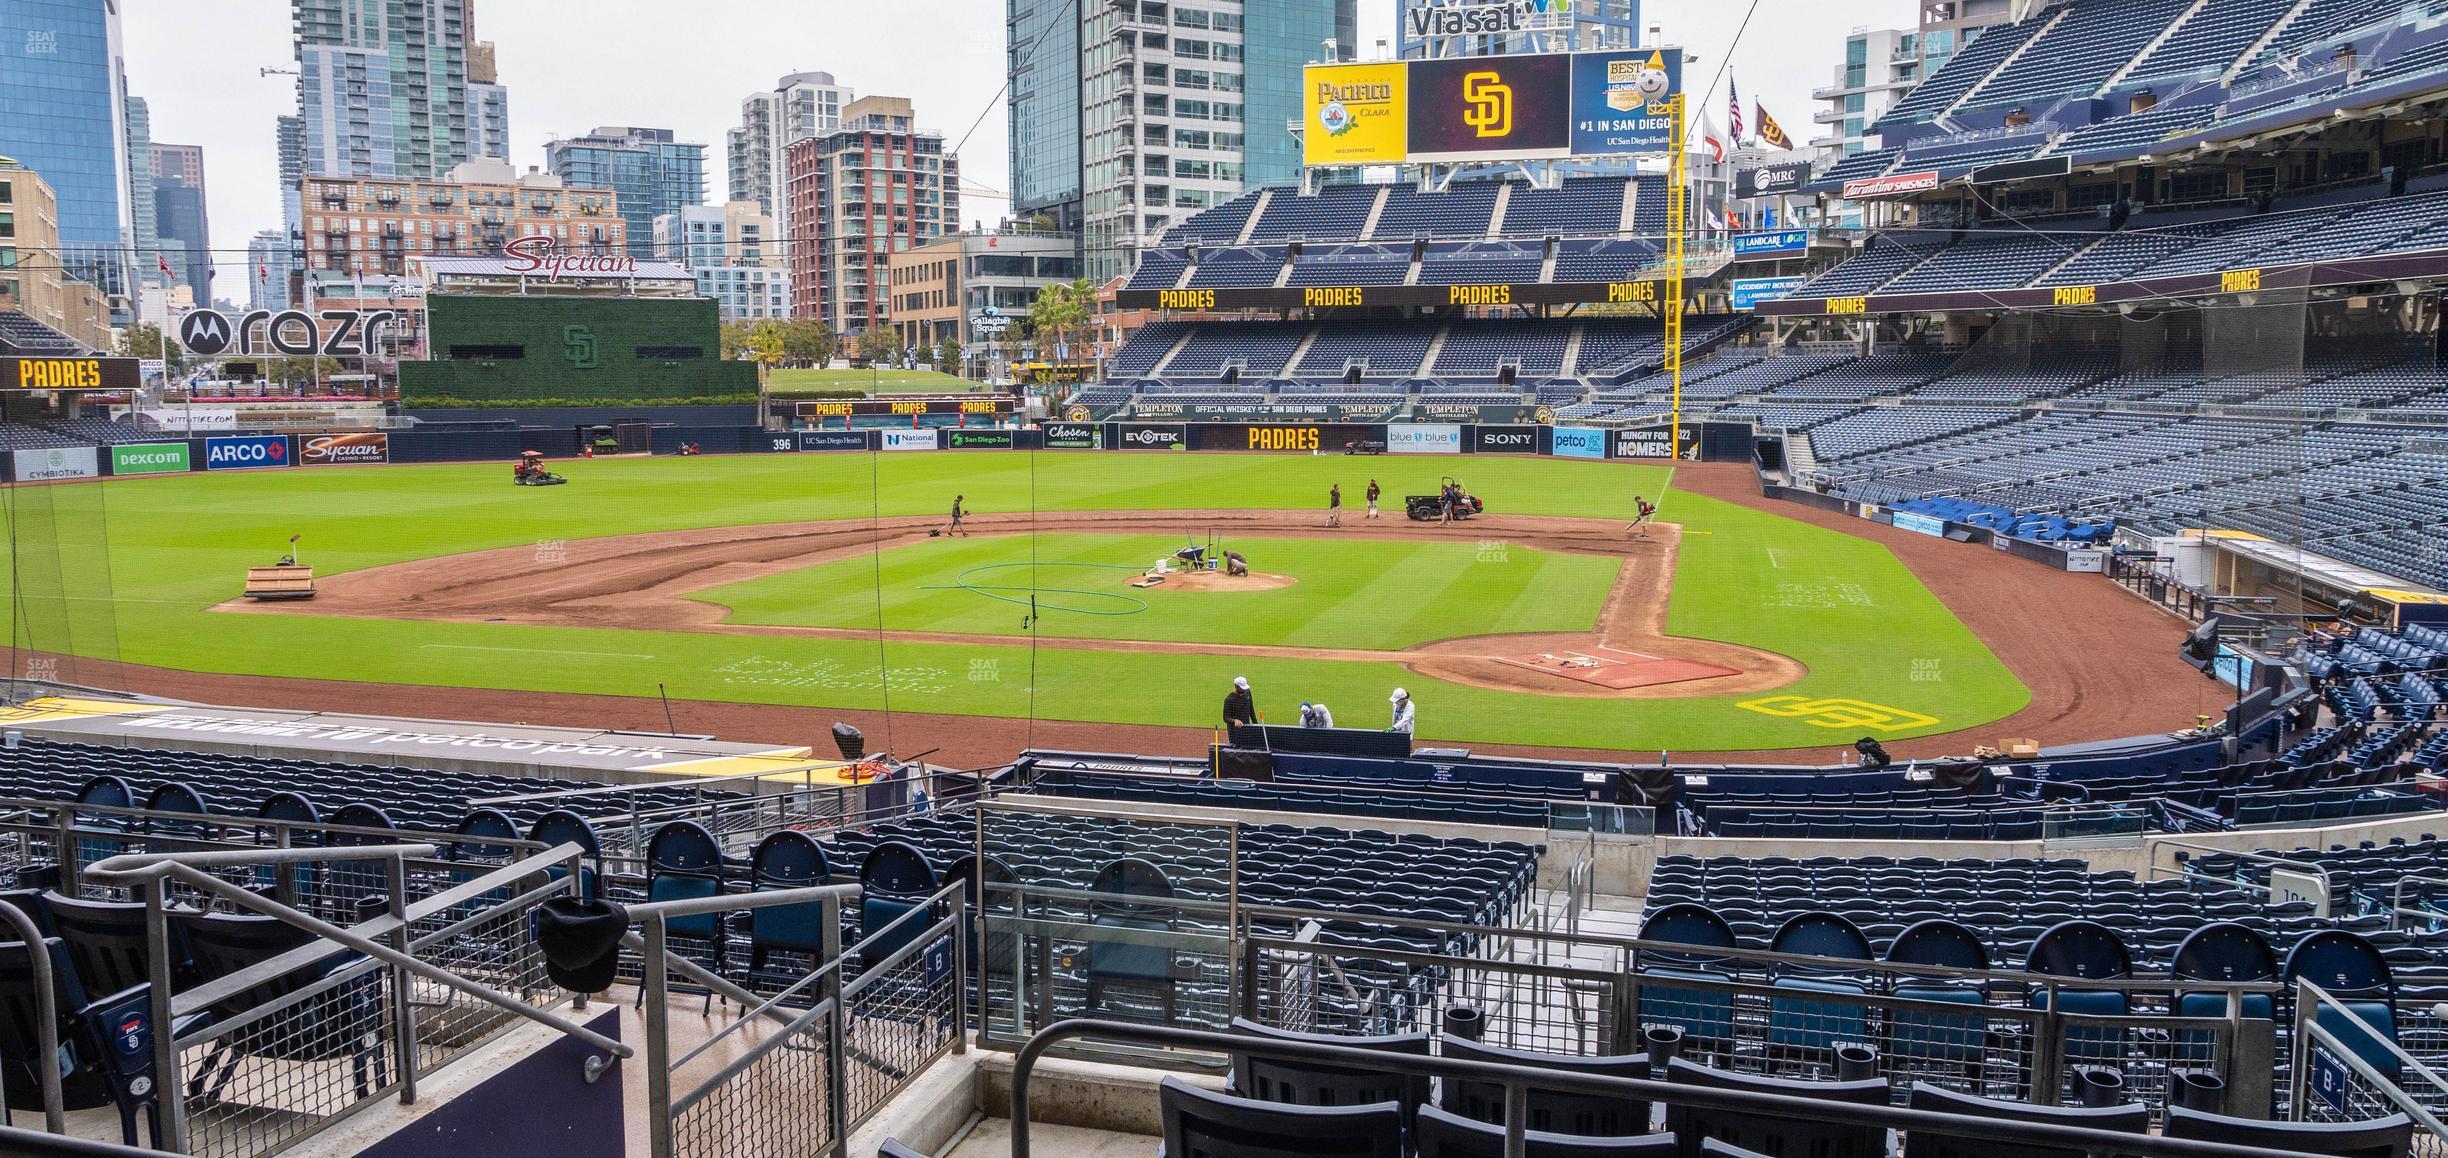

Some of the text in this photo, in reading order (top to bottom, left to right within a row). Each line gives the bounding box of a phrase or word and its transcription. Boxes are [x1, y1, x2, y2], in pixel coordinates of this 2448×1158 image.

[1411, 3, 1521, 36] Viasat
[1610, 62, 1642, 74] BEST
[1580, 118, 1670, 131] #1 IN SAN DIEGO
[1618, 137, 1630, 145] San
[1631, 136, 1649, 145] Diego
[1650, 135, 1670, 144] Health
[1770, 169, 1795, 182] MRC
[1846, 178, 1935, 196] Tarantino SAUSAGES
[1746, 233, 1806, 246] LANDCARE LOGIC
[504, 236, 638, 283] Sycuan
[2222, 269, 2260, 291] PADRES
[1305, 287, 1363, 307] PADRES
[1450, 284, 1510, 305] PADRES
[1609, 281, 1655, 302] PADRES
[2054, 286, 2096, 305] PADRES
[1160, 289, 1215, 308] PADRES
[1826, 297, 1866, 313] PADRES
[970, 317, 1011, 325] Gallagher
[239, 309, 395, 356] razr
[19, 359, 101, 387] PADRES
[817, 404, 852, 414] PADRES
[892, 402, 927, 413] PADRES
[962, 402, 996, 412] PADRES
[1135, 404, 1184, 413] TEMPLETON
[1195, 405, 1225, 413] OFFICIAL
[1226, 405, 1257, 413] WHISKEY
[1272, 405, 1285, 413] SAN
[1285, 405, 1303, 413] DIEGO
[1304, 405, 1327, 413] PADRES
[1339, 405, 1393, 414] TEMPLETON
[1425, 405, 1479, 414] TEMPLETON
[166, 415, 233, 424] NITTTIRE.COM
[1049, 425, 1089, 437] Chosen
[1390, 432, 1412, 442] blue
[1425, 432, 1447, 442] blue
[1621, 431, 1669, 440] HUNGRY FOR
[773, 439, 791, 451] 396
[826, 437, 843, 446] Diego
[843, 436, 862, 444] Health
[979, 436, 996, 445] Diego
[1249, 427, 1320, 450] PADRES
[1485, 434, 1532, 444] SONY
[1556, 434, 1586, 448] petco
[210, 444, 266, 462] ARCO
[305, 437, 379, 462] Sycuan
[1617, 441, 1672, 457] HOMERS
[30, 469, 84, 478] CYMBIOTIKA
[370, 733, 546, 750] petco
[531, 742, 665, 759] park
[936, 952, 942, 971] B
[2324, 1068, 2332, 1092] B
